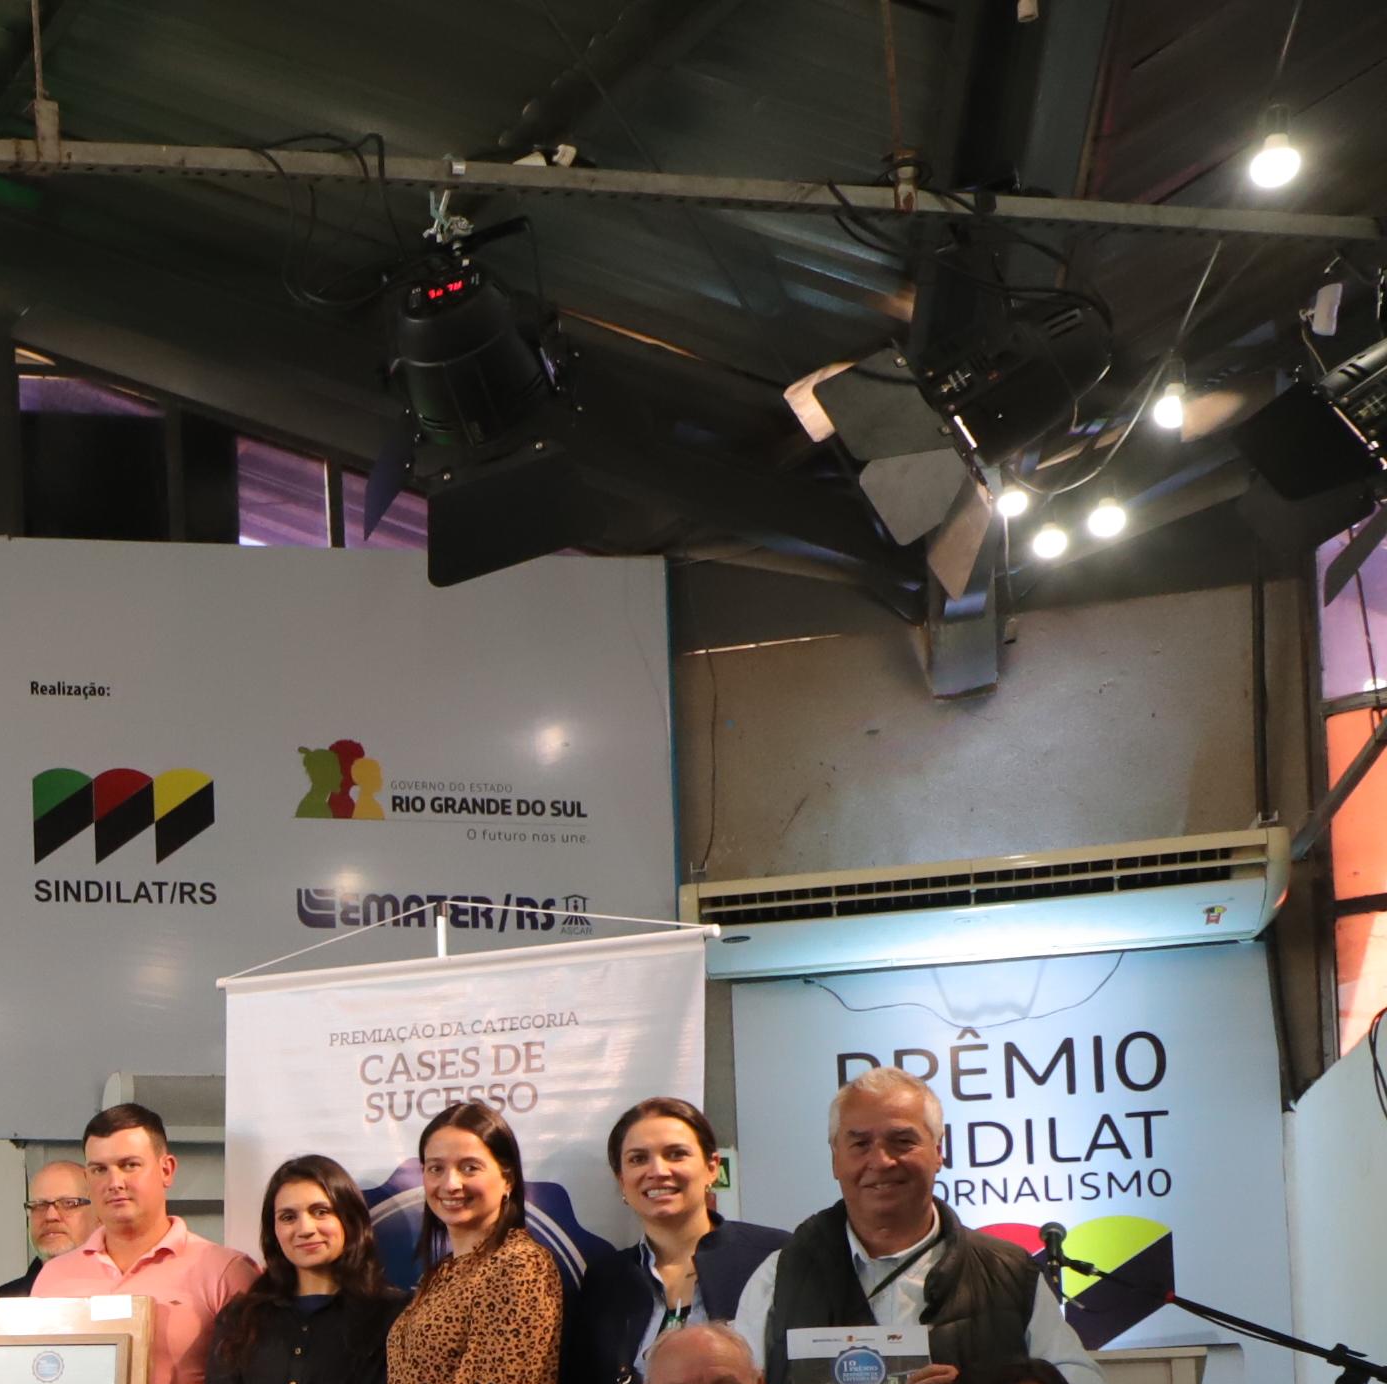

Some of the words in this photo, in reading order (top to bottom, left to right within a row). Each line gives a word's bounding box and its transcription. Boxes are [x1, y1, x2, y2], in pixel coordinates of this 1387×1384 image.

[30, 681, 111, 700] Realização:
[390, 780, 445, 792] GOVERNO
[449, 782, 466, 792] DO
[470, 783, 514, 794] ESTADO
[391, 795, 426, 813] RIO
[430, 796, 513, 816] GRANDE
[516, 799, 546, 817] DO
[550, 800, 588, 818] SUL
[466, 828, 477, 841] O
[482, 828, 527, 842] futuro
[532, 832, 557, 843] nos
[34, 879, 217, 905] SINDILAT/RS
[339, 893, 557, 932] EMATER/RS
[329, 1022, 435, 1047] PREMIAÇÃO
[439, 1022, 467, 1037] DA
[470, 1011, 580, 1034] CATEGORIA
[359, 1046, 481, 1086] CASES
[491, 1041, 546, 1075] DE
[933, 1168, 1172, 1206] ORNALISMO
